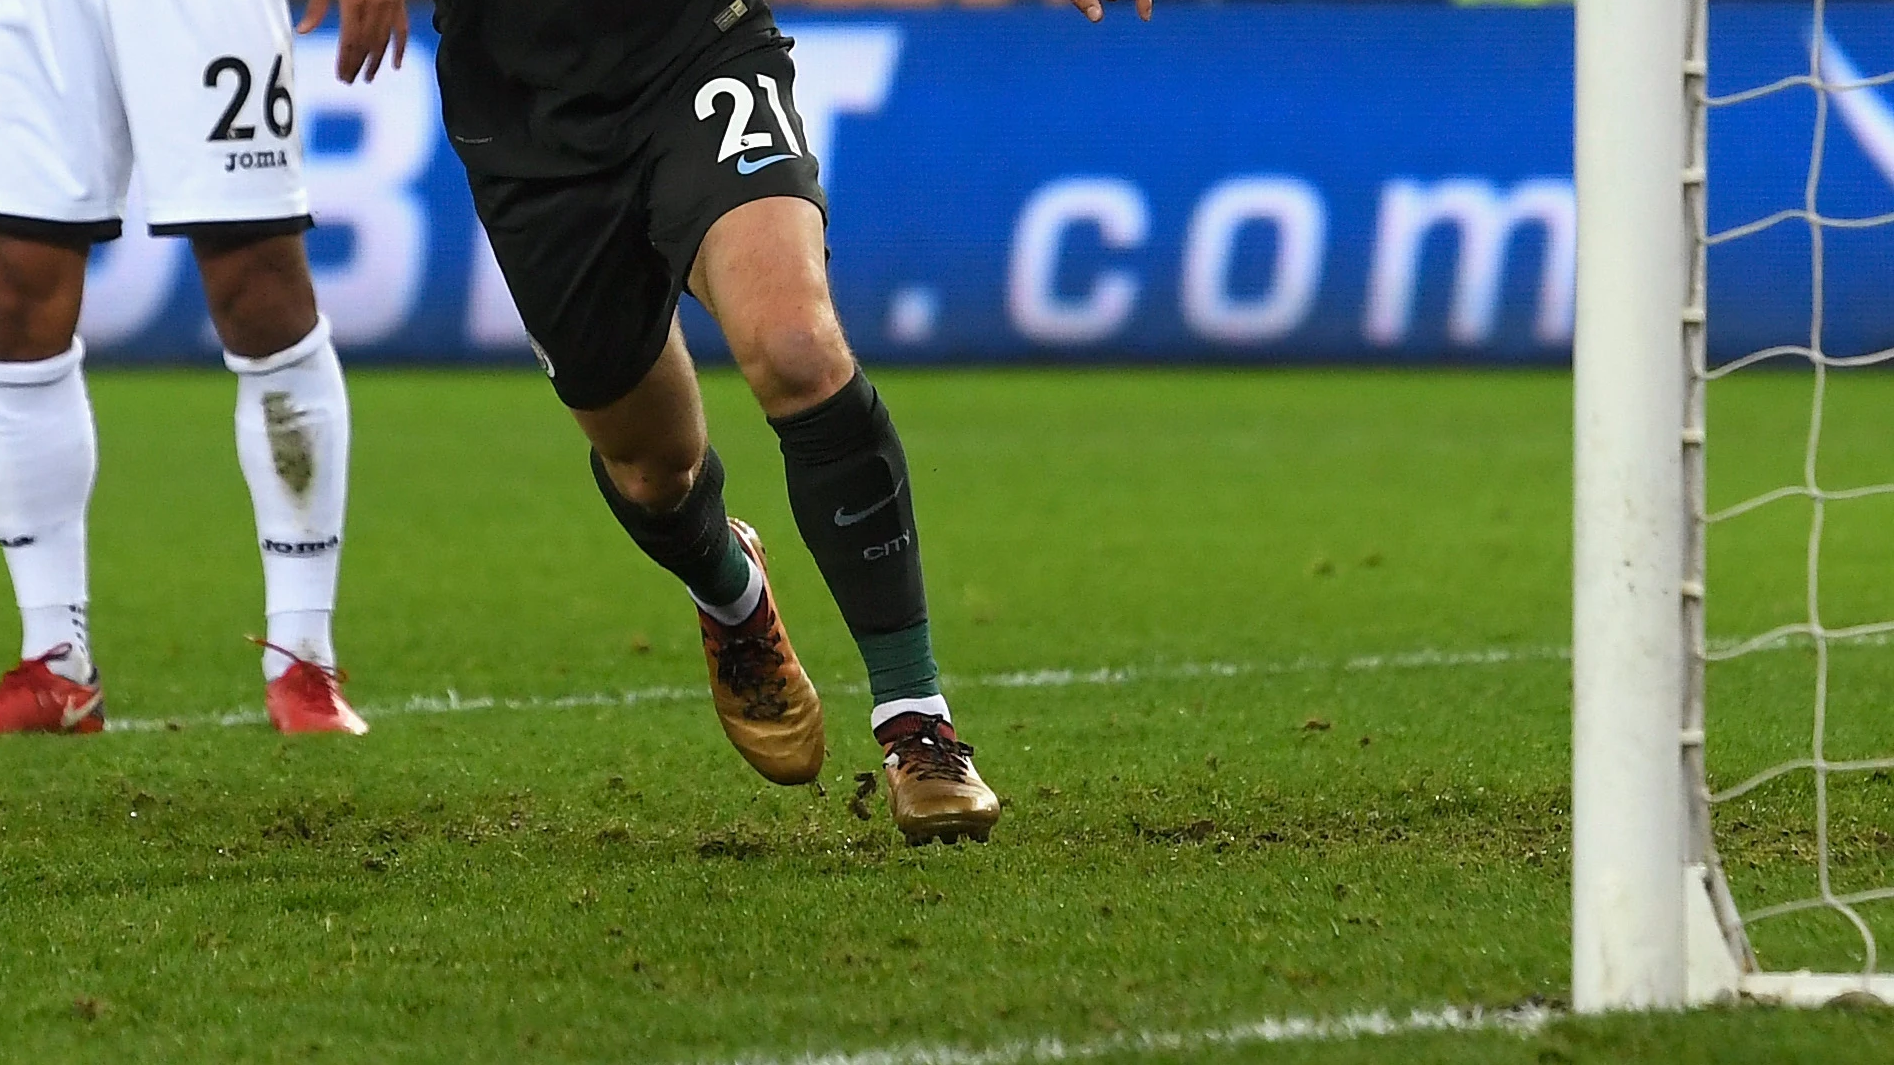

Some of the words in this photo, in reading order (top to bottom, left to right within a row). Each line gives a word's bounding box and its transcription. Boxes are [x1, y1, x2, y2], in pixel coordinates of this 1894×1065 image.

[203, 54, 294, 142] 26
[694, 74, 803, 163] 21
[863, 529, 911, 561] CITY
